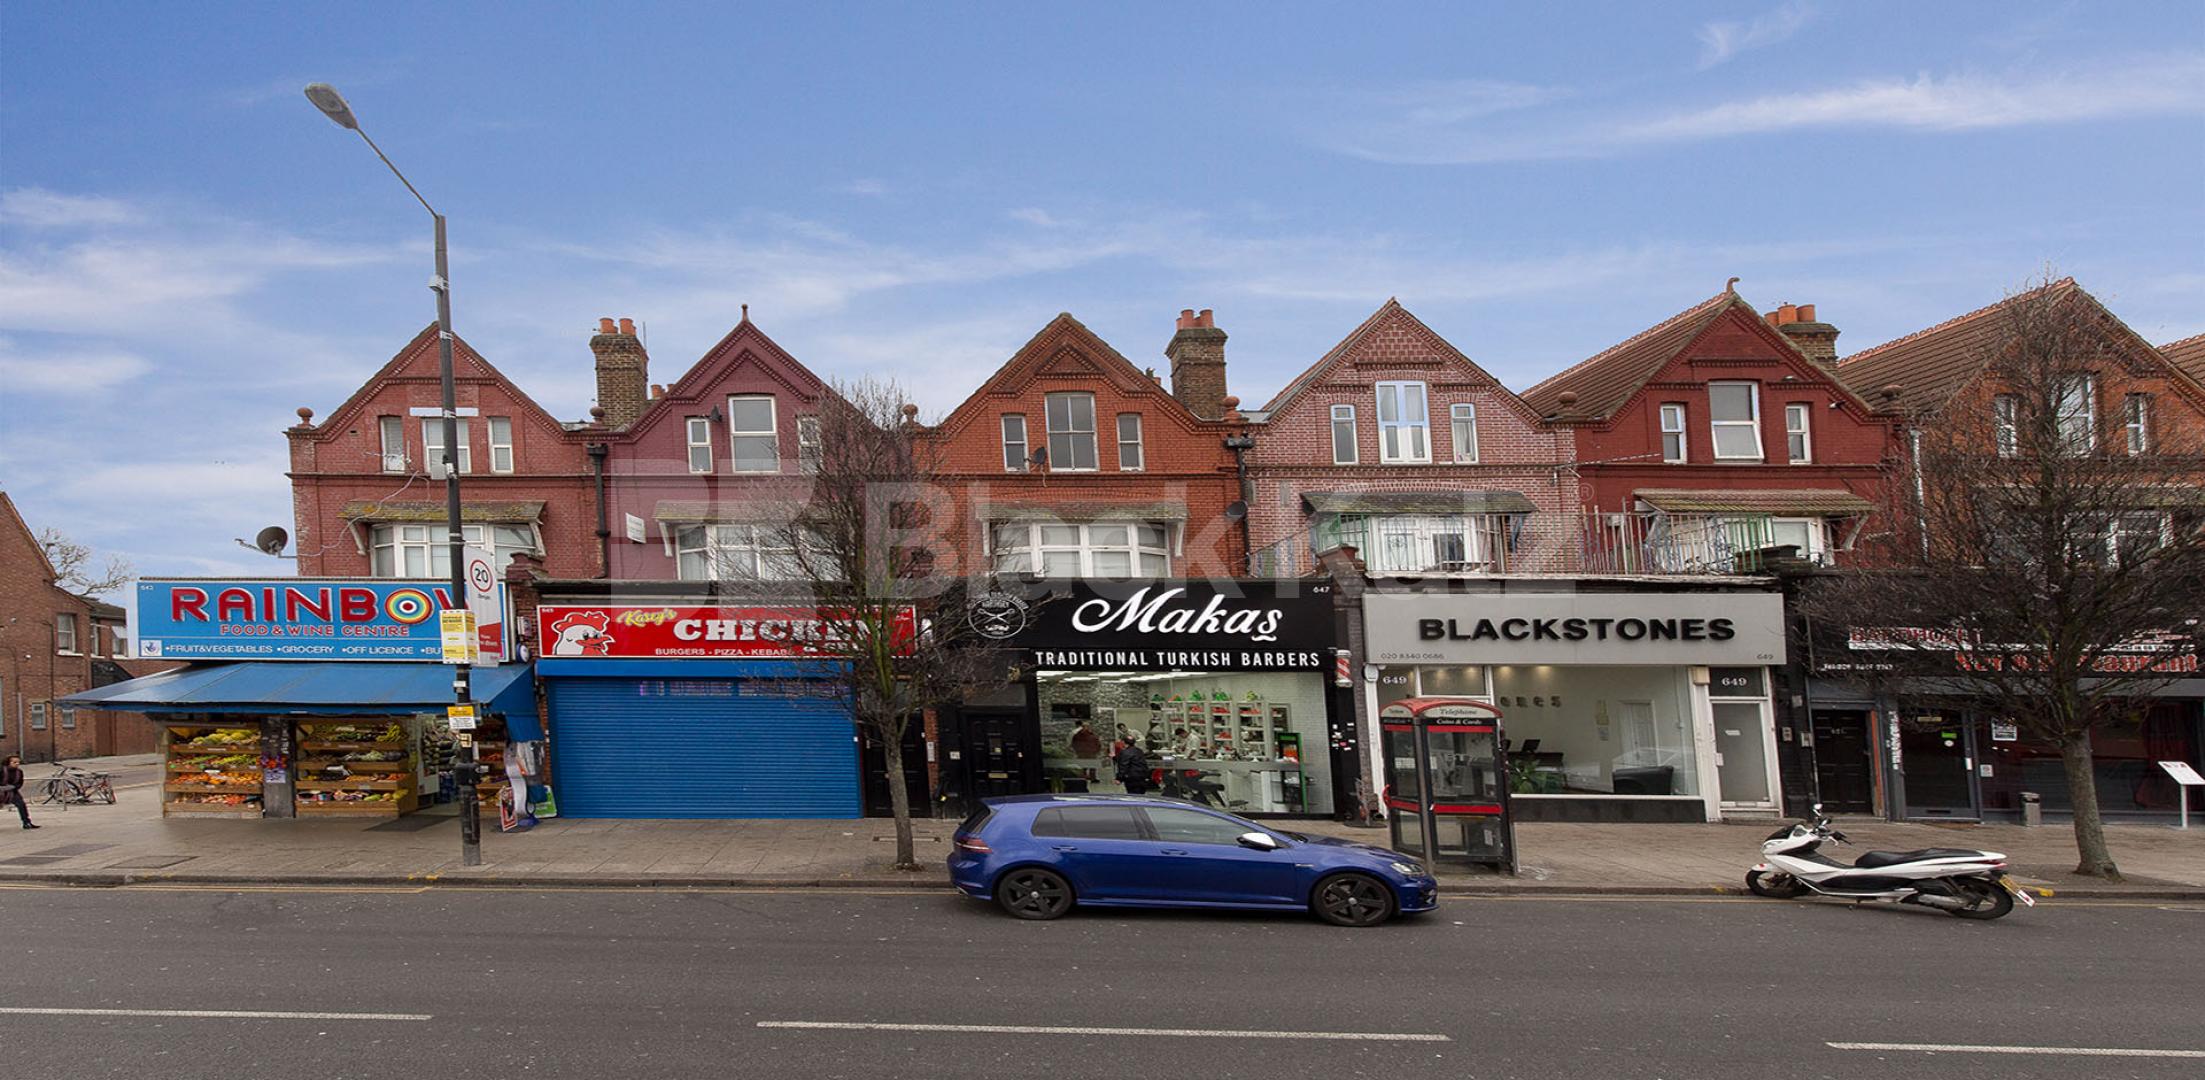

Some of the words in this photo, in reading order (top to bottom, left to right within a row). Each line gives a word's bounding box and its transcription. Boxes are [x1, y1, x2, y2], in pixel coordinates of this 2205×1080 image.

[474, 567, 489, 583] 20
[171, 586, 468, 625] RAINBO
[220, 625, 268, 635] FOOD
[272, 625, 284, 635] &
[286, 625, 334, 636] WINE
[342, 625, 410, 636] CENTRE
[1419, 618, 1736, 641] BLACKSTONES
[281, 646, 335, 654] GROCERY
[345, 646, 367, 654] OFF
[369, 646, 414, 654] LICENCE
[655, 648, 705, 656] BURGERS
[1036, 652, 1148, 666] TRADITIONAL
[1157, 653, 1231, 666] TURKISH
[1242, 653, 1320, 667] BARBERS
[1382, 675, 1408, 685] 649
[1721, 677, 1748, 686] 649
